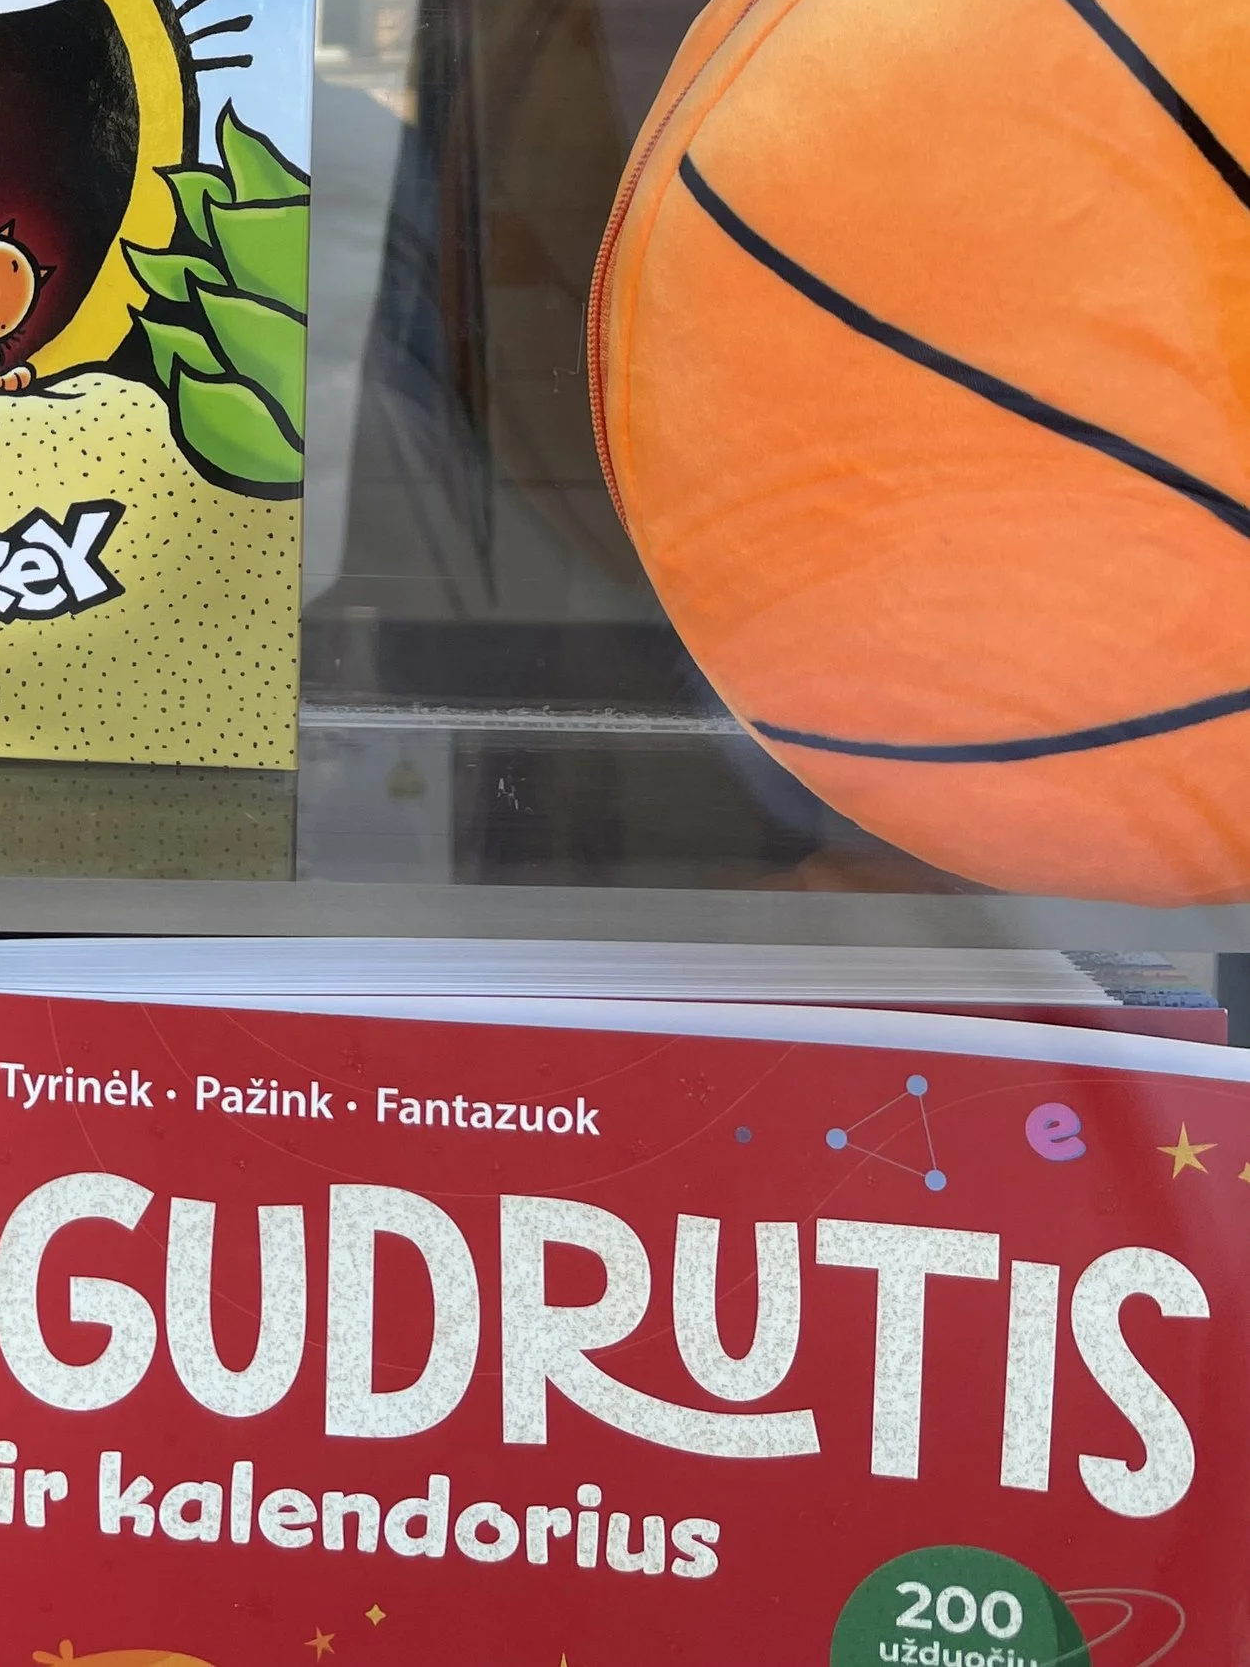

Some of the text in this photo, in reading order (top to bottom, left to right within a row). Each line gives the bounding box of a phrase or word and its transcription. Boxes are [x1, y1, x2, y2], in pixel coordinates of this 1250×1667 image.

[0, 1061, 601, 1136] Tyrinėk Pažink Fantazuok
[100, 1449, 721, 1579] kalendorius
[895, 1581, 1024, 1640] 200
